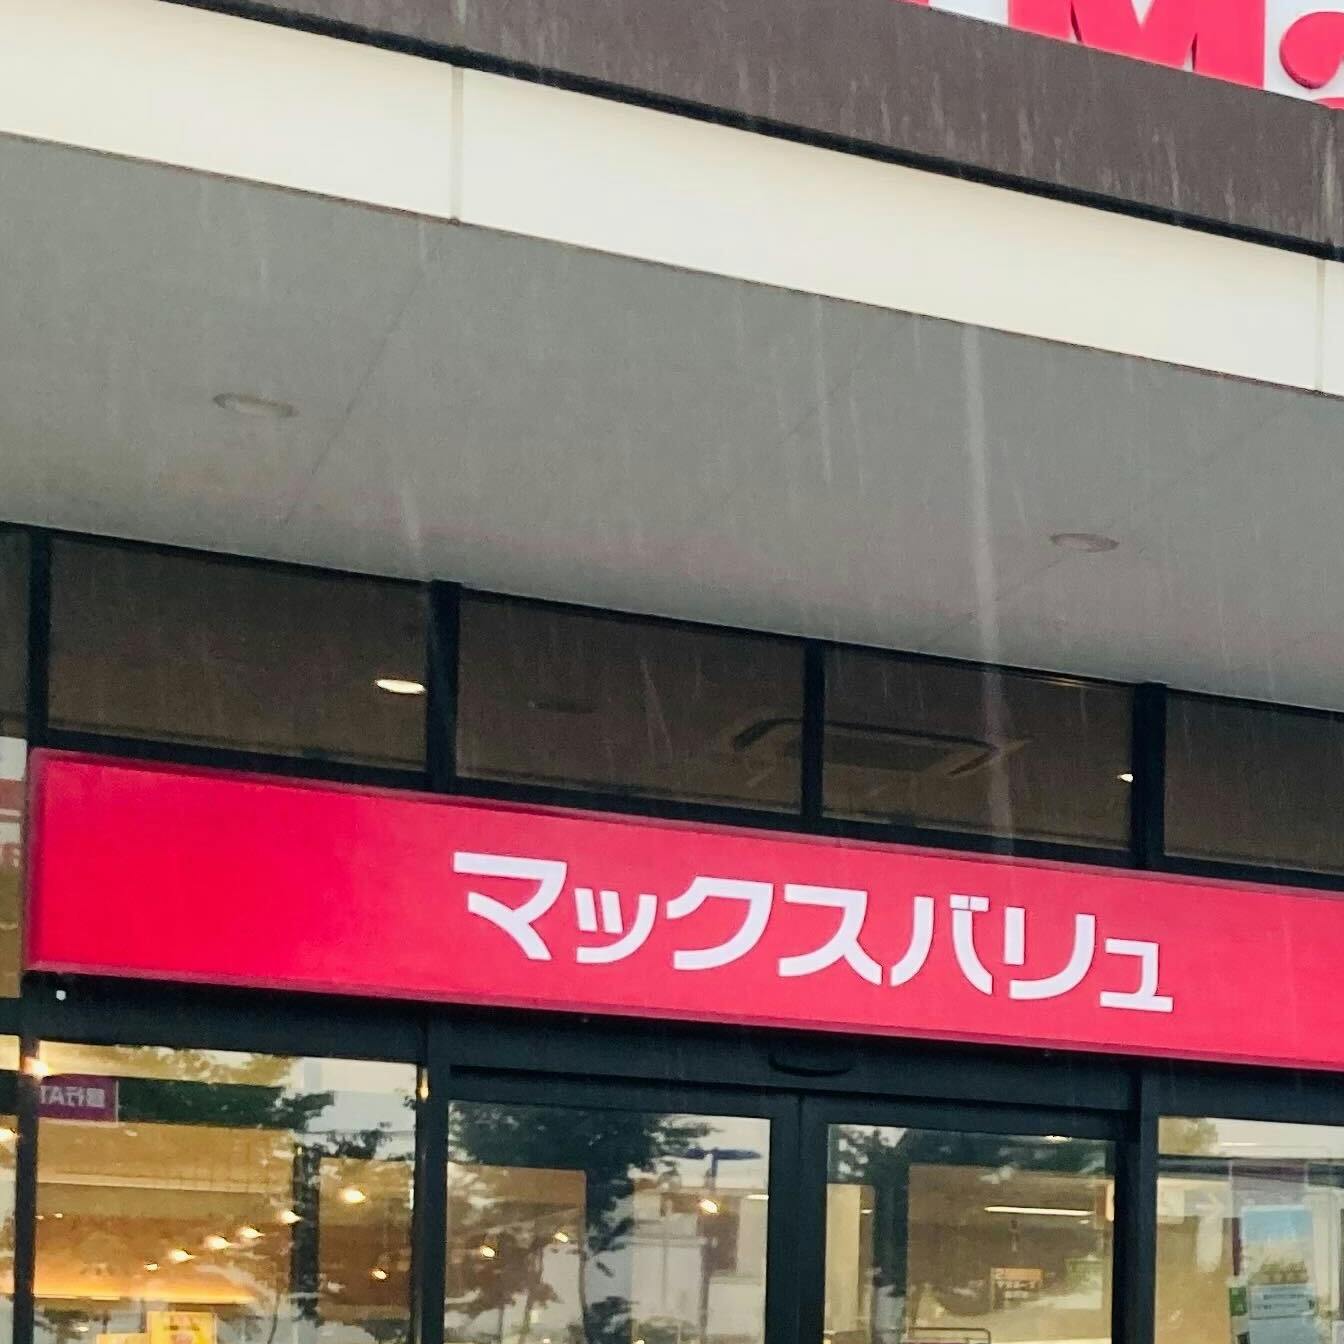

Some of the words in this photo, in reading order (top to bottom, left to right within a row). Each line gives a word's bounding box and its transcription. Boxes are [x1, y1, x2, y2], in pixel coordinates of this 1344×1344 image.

[453, 852, 1174, 1012] マックスバリュ
